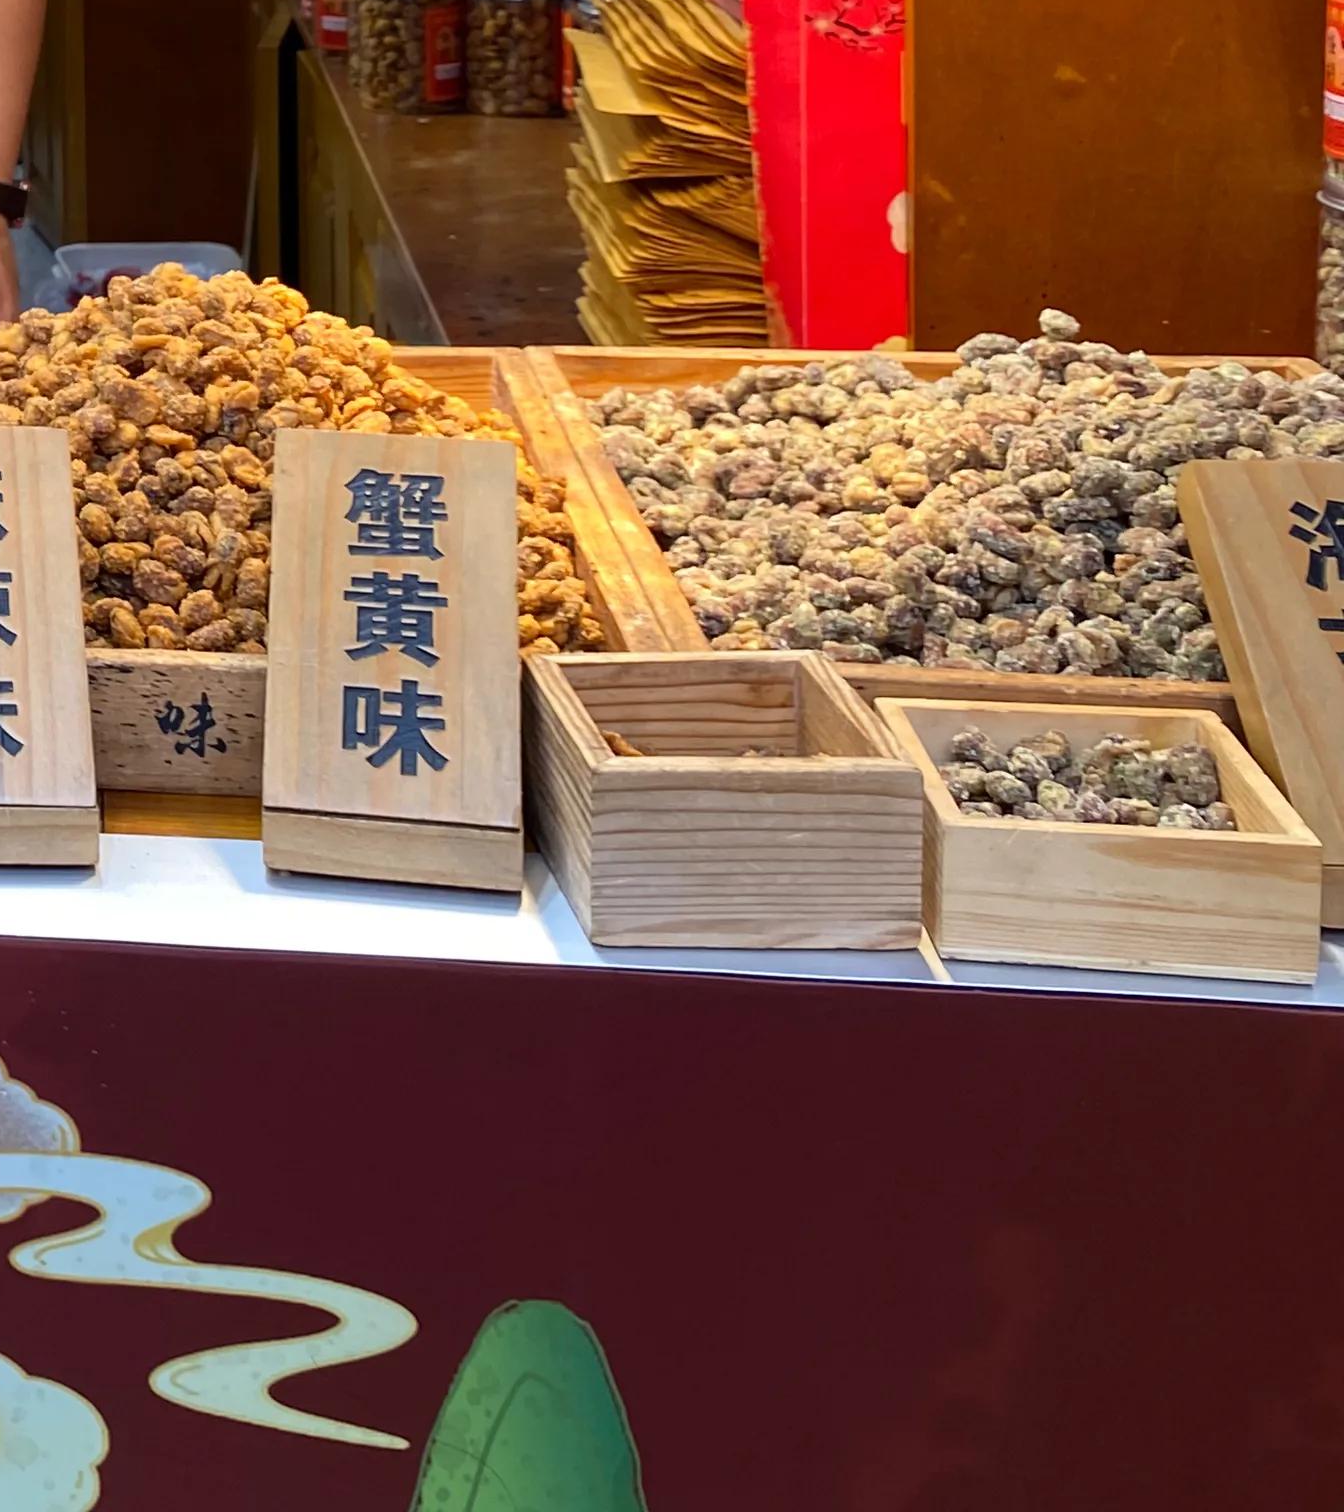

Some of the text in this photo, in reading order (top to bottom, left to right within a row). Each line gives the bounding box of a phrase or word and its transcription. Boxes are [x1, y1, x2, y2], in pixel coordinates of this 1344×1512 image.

[340, 467, 451, 778] 蟹黄味
[154, 691, 228, 760] 味
